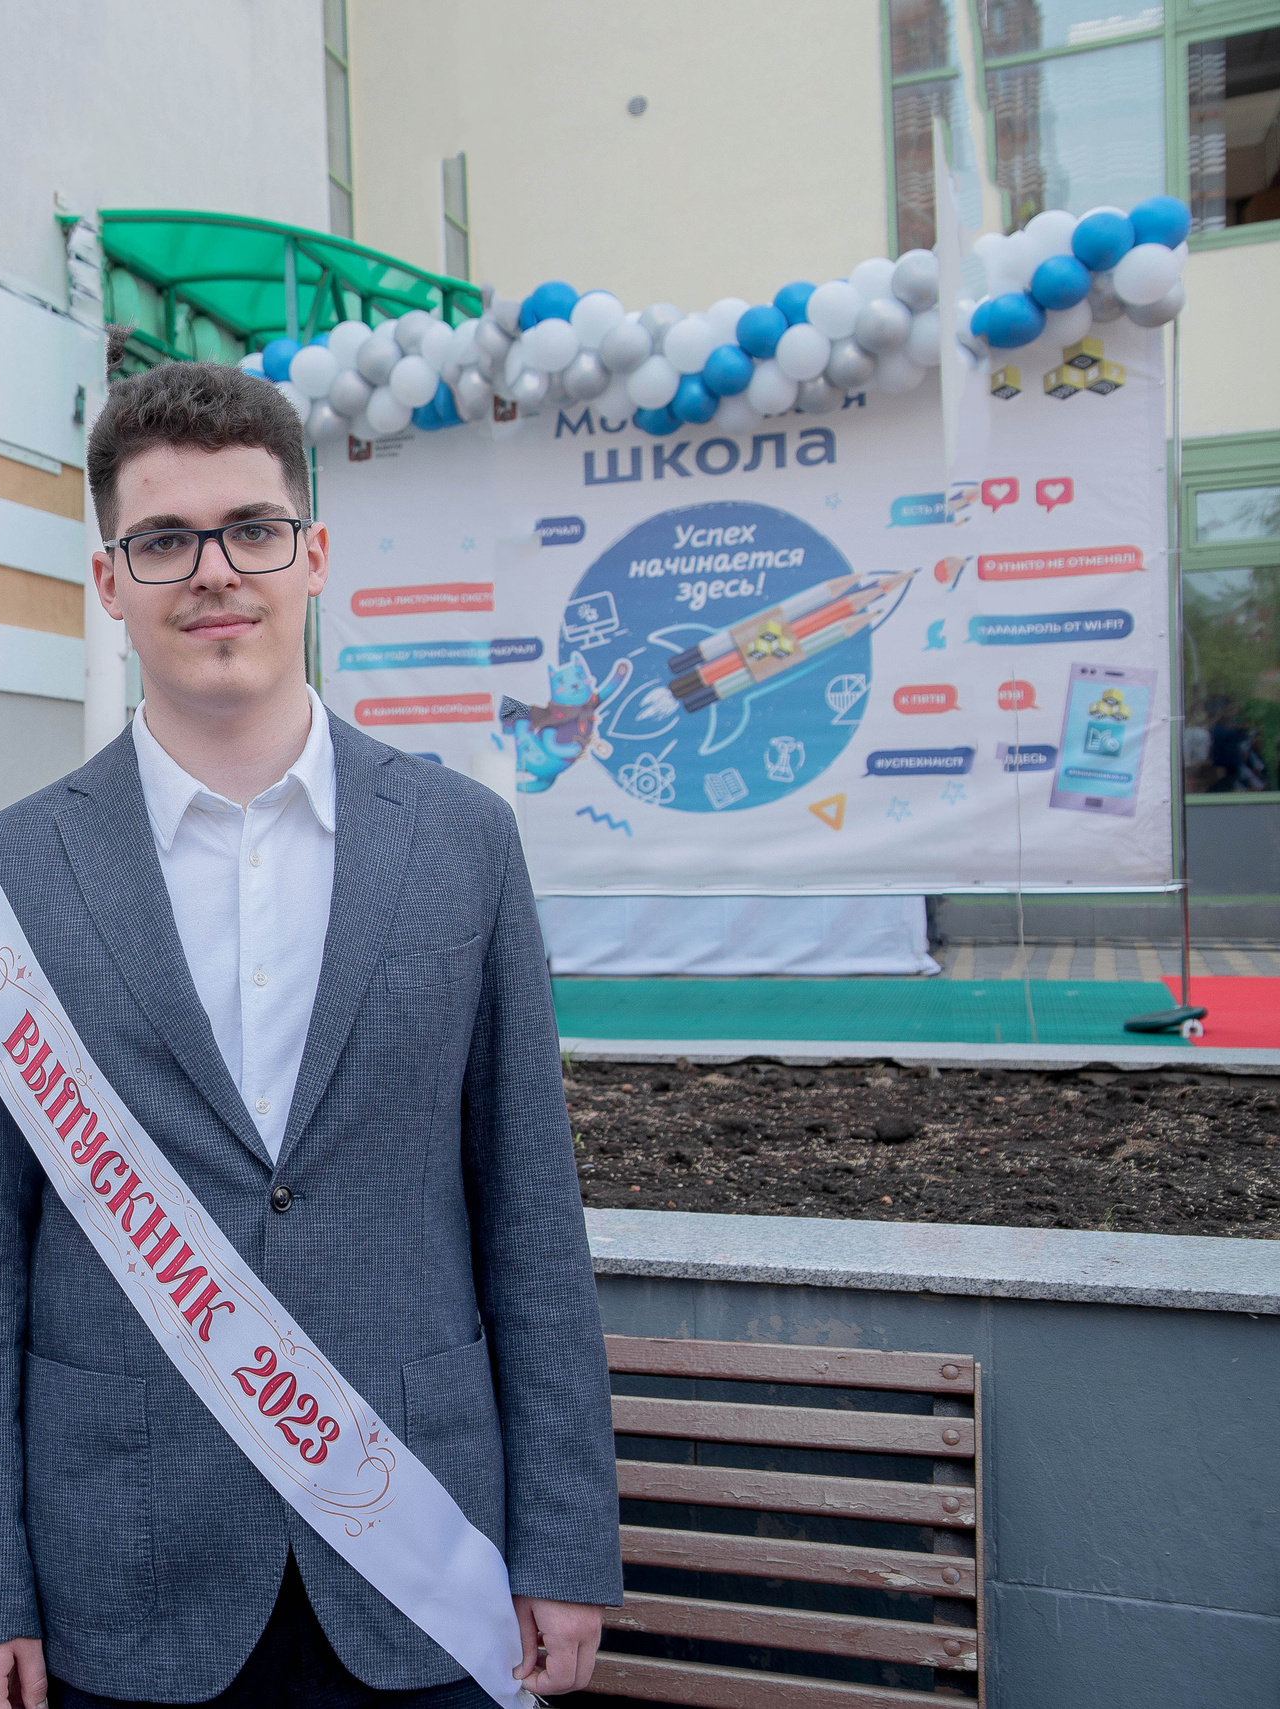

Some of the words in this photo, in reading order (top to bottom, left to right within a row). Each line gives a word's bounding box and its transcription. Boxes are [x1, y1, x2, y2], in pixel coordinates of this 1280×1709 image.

[584, 426, 837, 486] школа
[672, 523, 758, 550] Успех
[628, 547, 806, 579] начинается
[1065, 551, 1136, 569] ОТМЕНЯЛ!
[675, 570, 767, 612] здесь!
[1062, 620, 1082, 634] ОТ
[1083, 617, 1125, 632] WI-FI?
[2, 1008, 236, 1343] ВЫПУСКНИК
[231, 1345, 340, 1465] 2023
